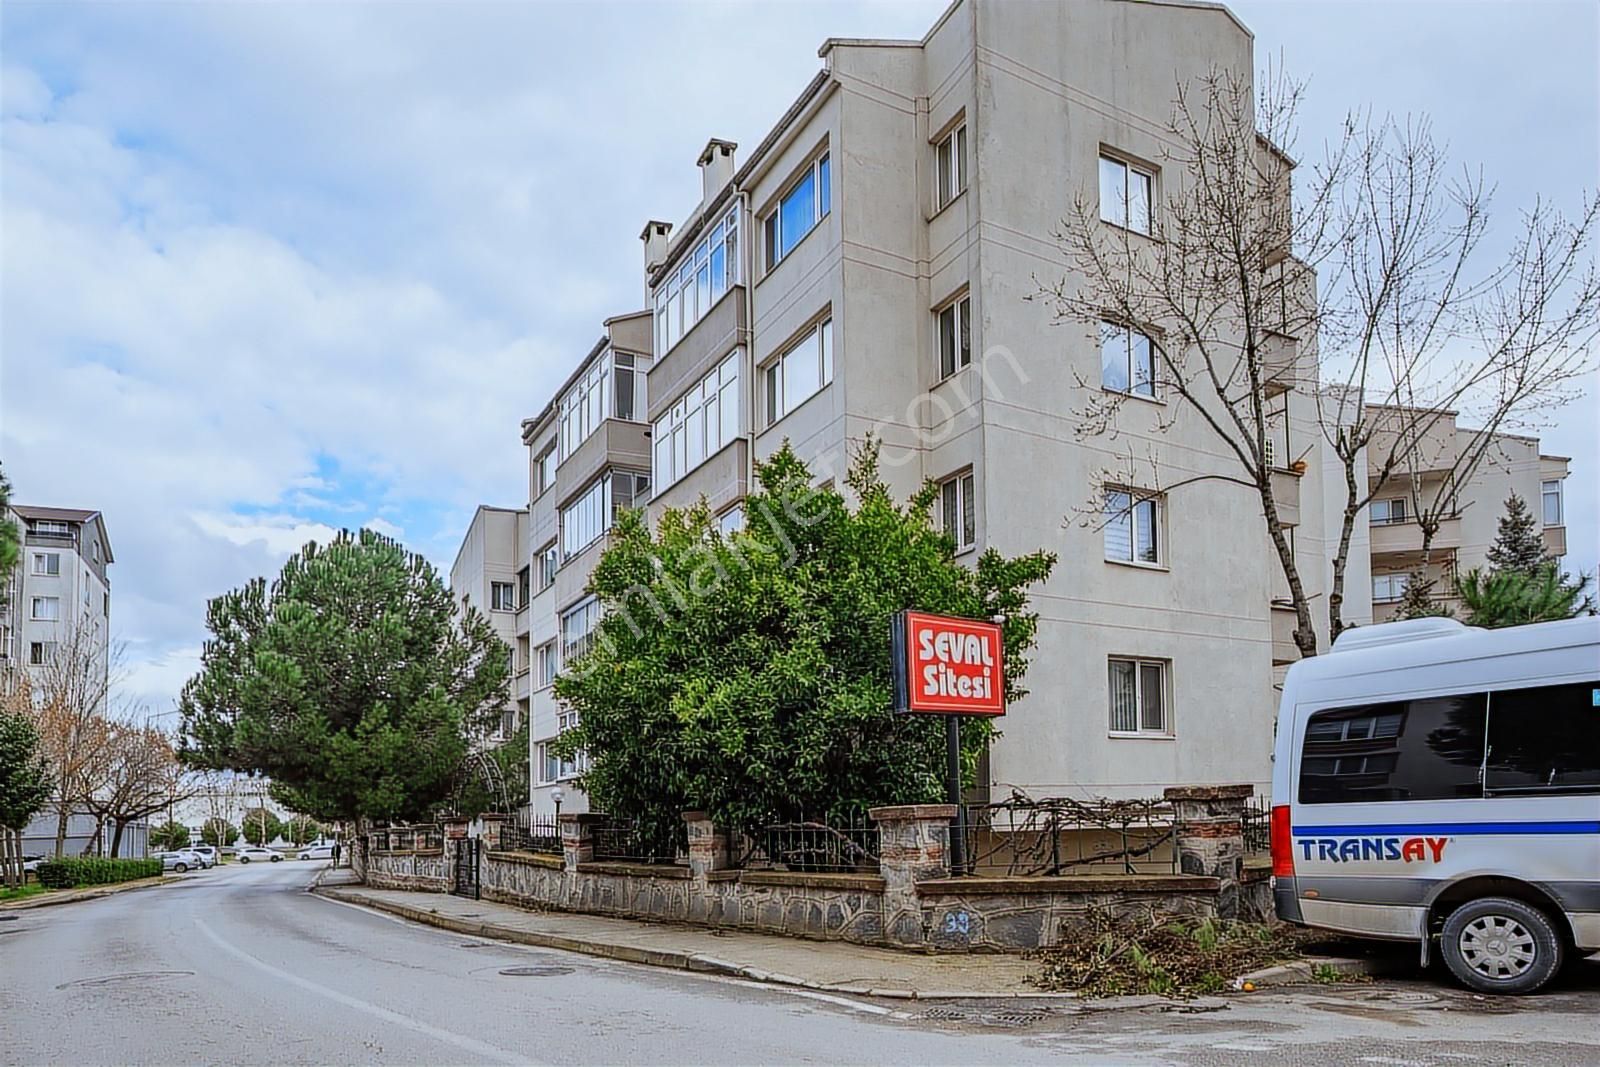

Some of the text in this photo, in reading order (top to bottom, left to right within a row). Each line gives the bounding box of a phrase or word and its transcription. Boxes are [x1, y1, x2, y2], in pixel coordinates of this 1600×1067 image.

[919, 629, 993, 667] SEVAL
[923, 662, 992, 699] Sitesi
[1297, 838, 1448, 863] TRANSAY
